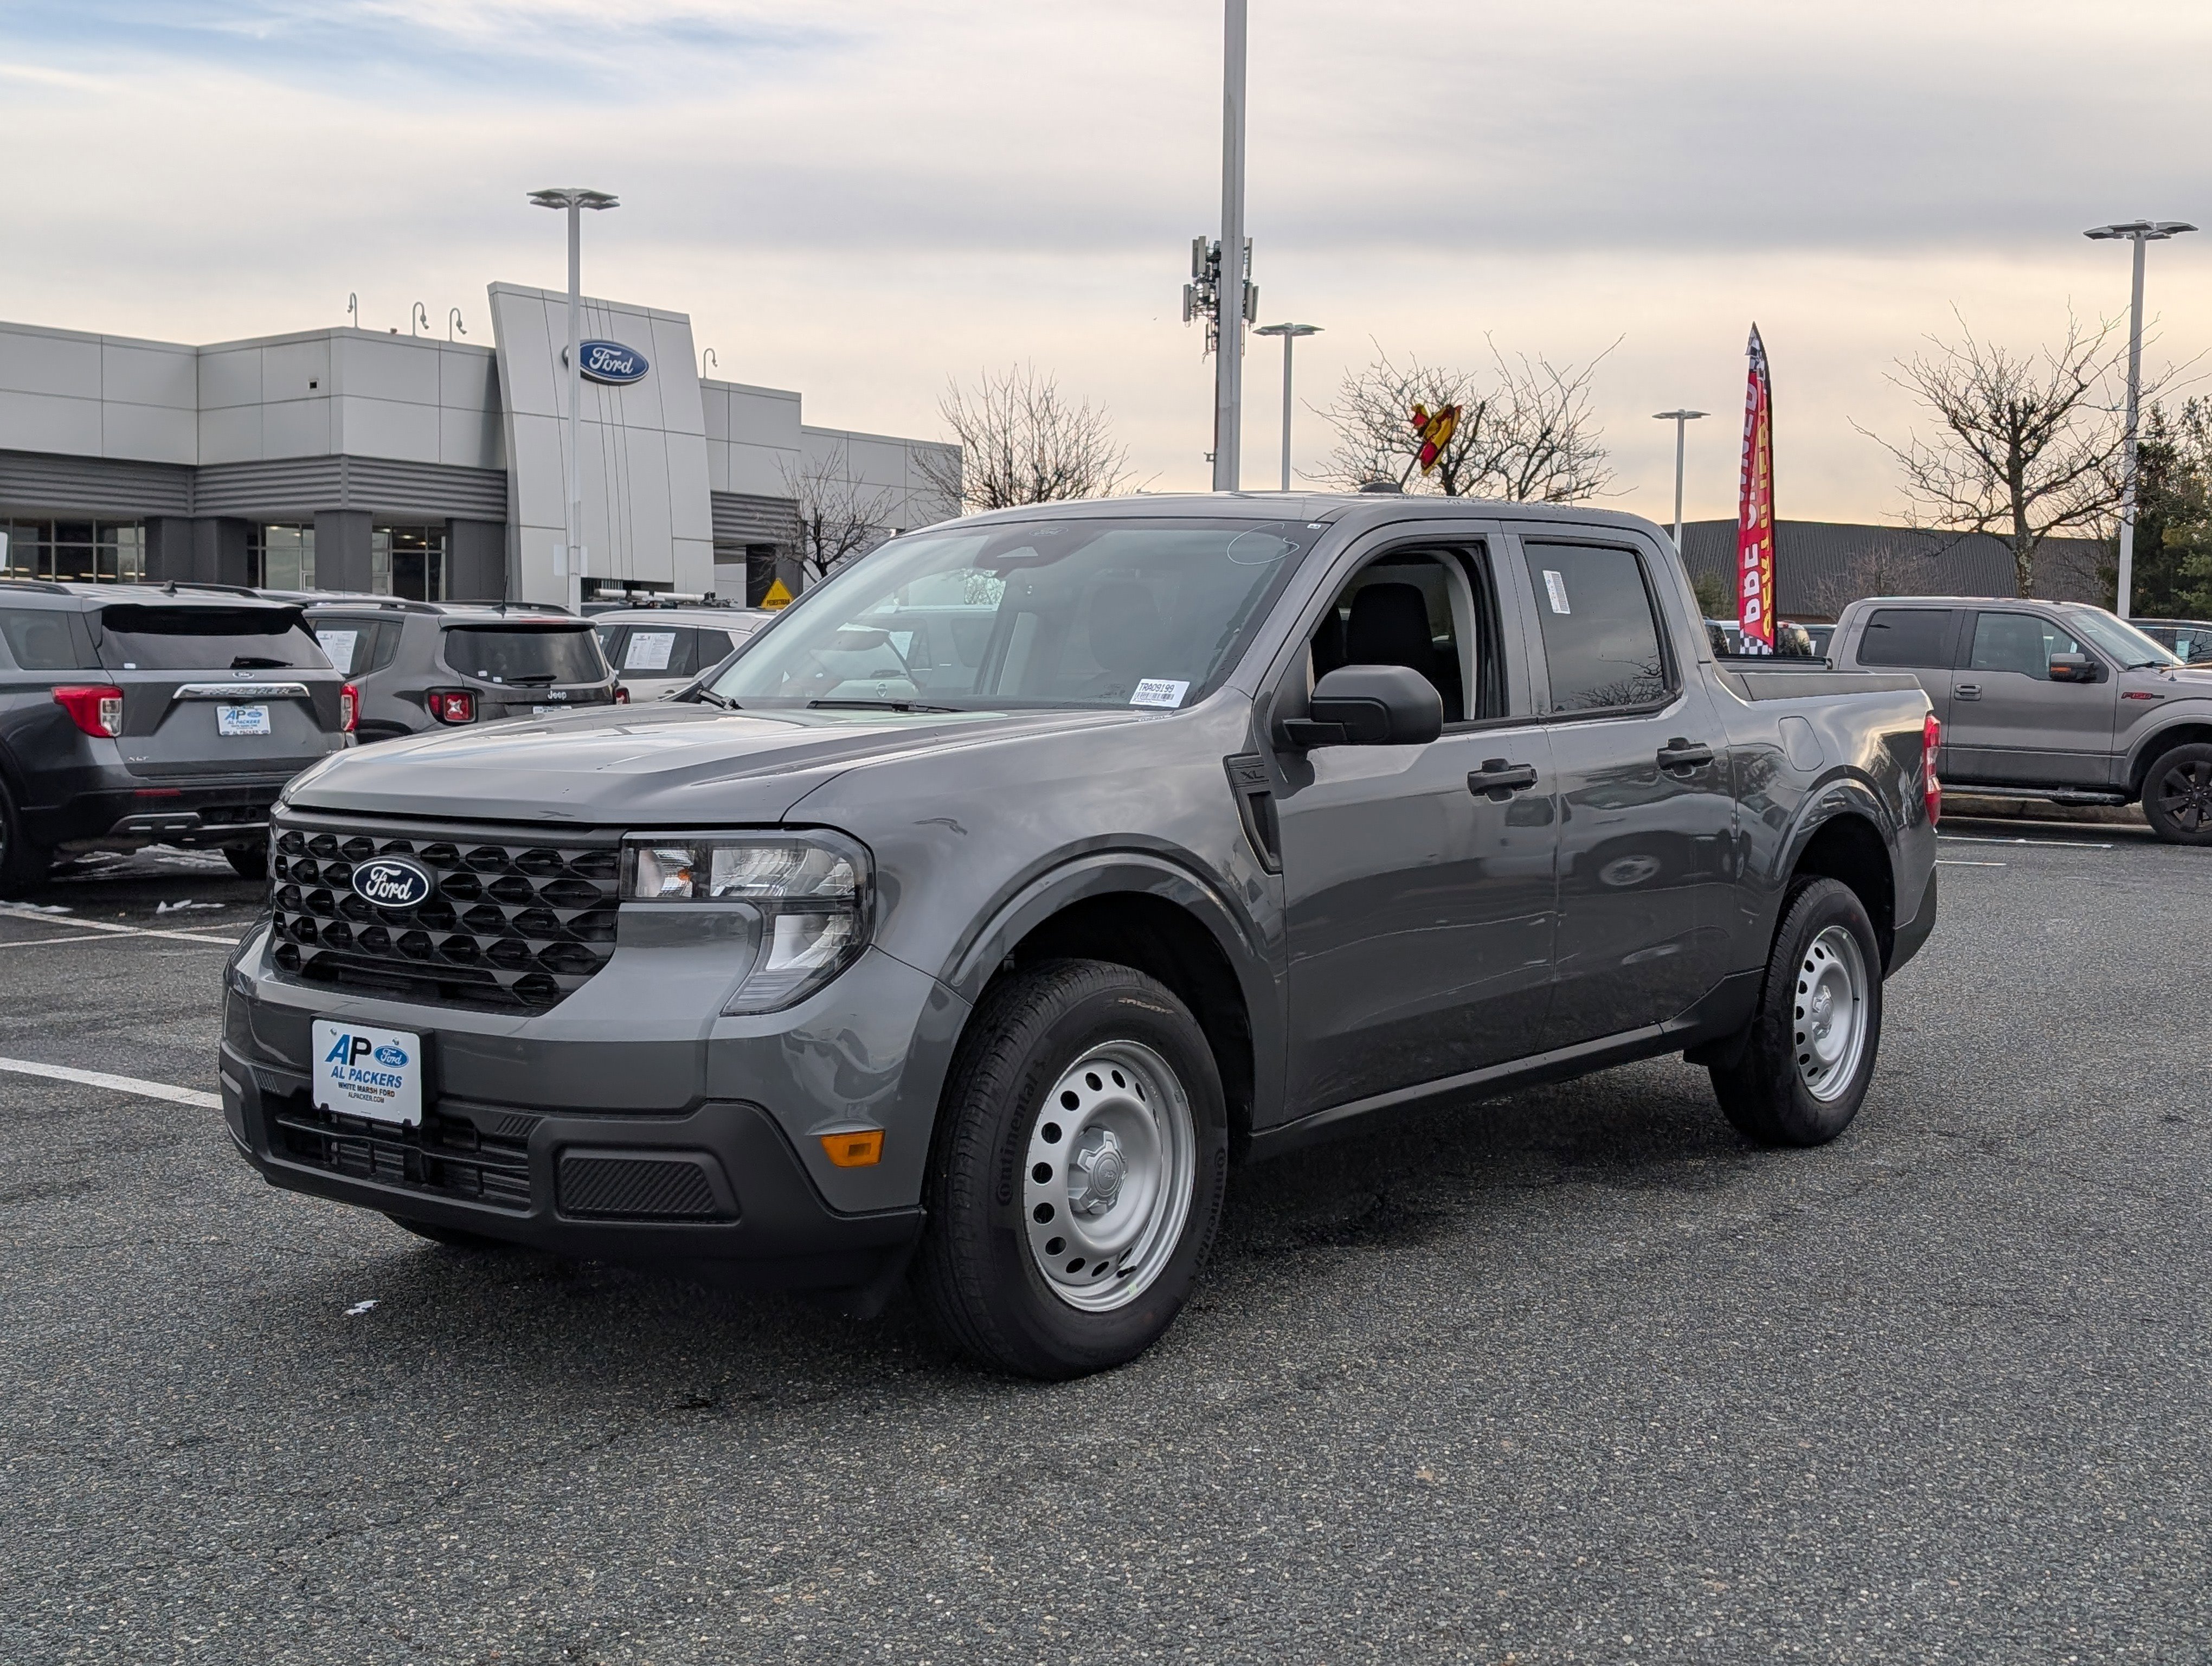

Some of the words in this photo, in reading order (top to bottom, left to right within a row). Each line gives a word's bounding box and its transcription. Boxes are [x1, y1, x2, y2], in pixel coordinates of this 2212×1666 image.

[589, 347, 634, 374] Ford
[548, 690, 567, 700] Jeep
[1140, 683, 1175, 693] TRA09199
[224, 710, 246, 720] AP
[1240, 770, 1265, 780] XL
[365, 866, 413, 900] Ford
[325, 1034, 372, 1066] AP
[380, 1047, 402, 1065] Ford
[330, 1066, 345, 1080] AL
[348, 1068, 403, 1089] PACKERS
[338, 1081, 356, 1091] WHITE
[357, 1085, 378, 1095] MARSH
[379, 1088, 395, 1098] FORD
[996, 1072, 1038, 1207] Continental
